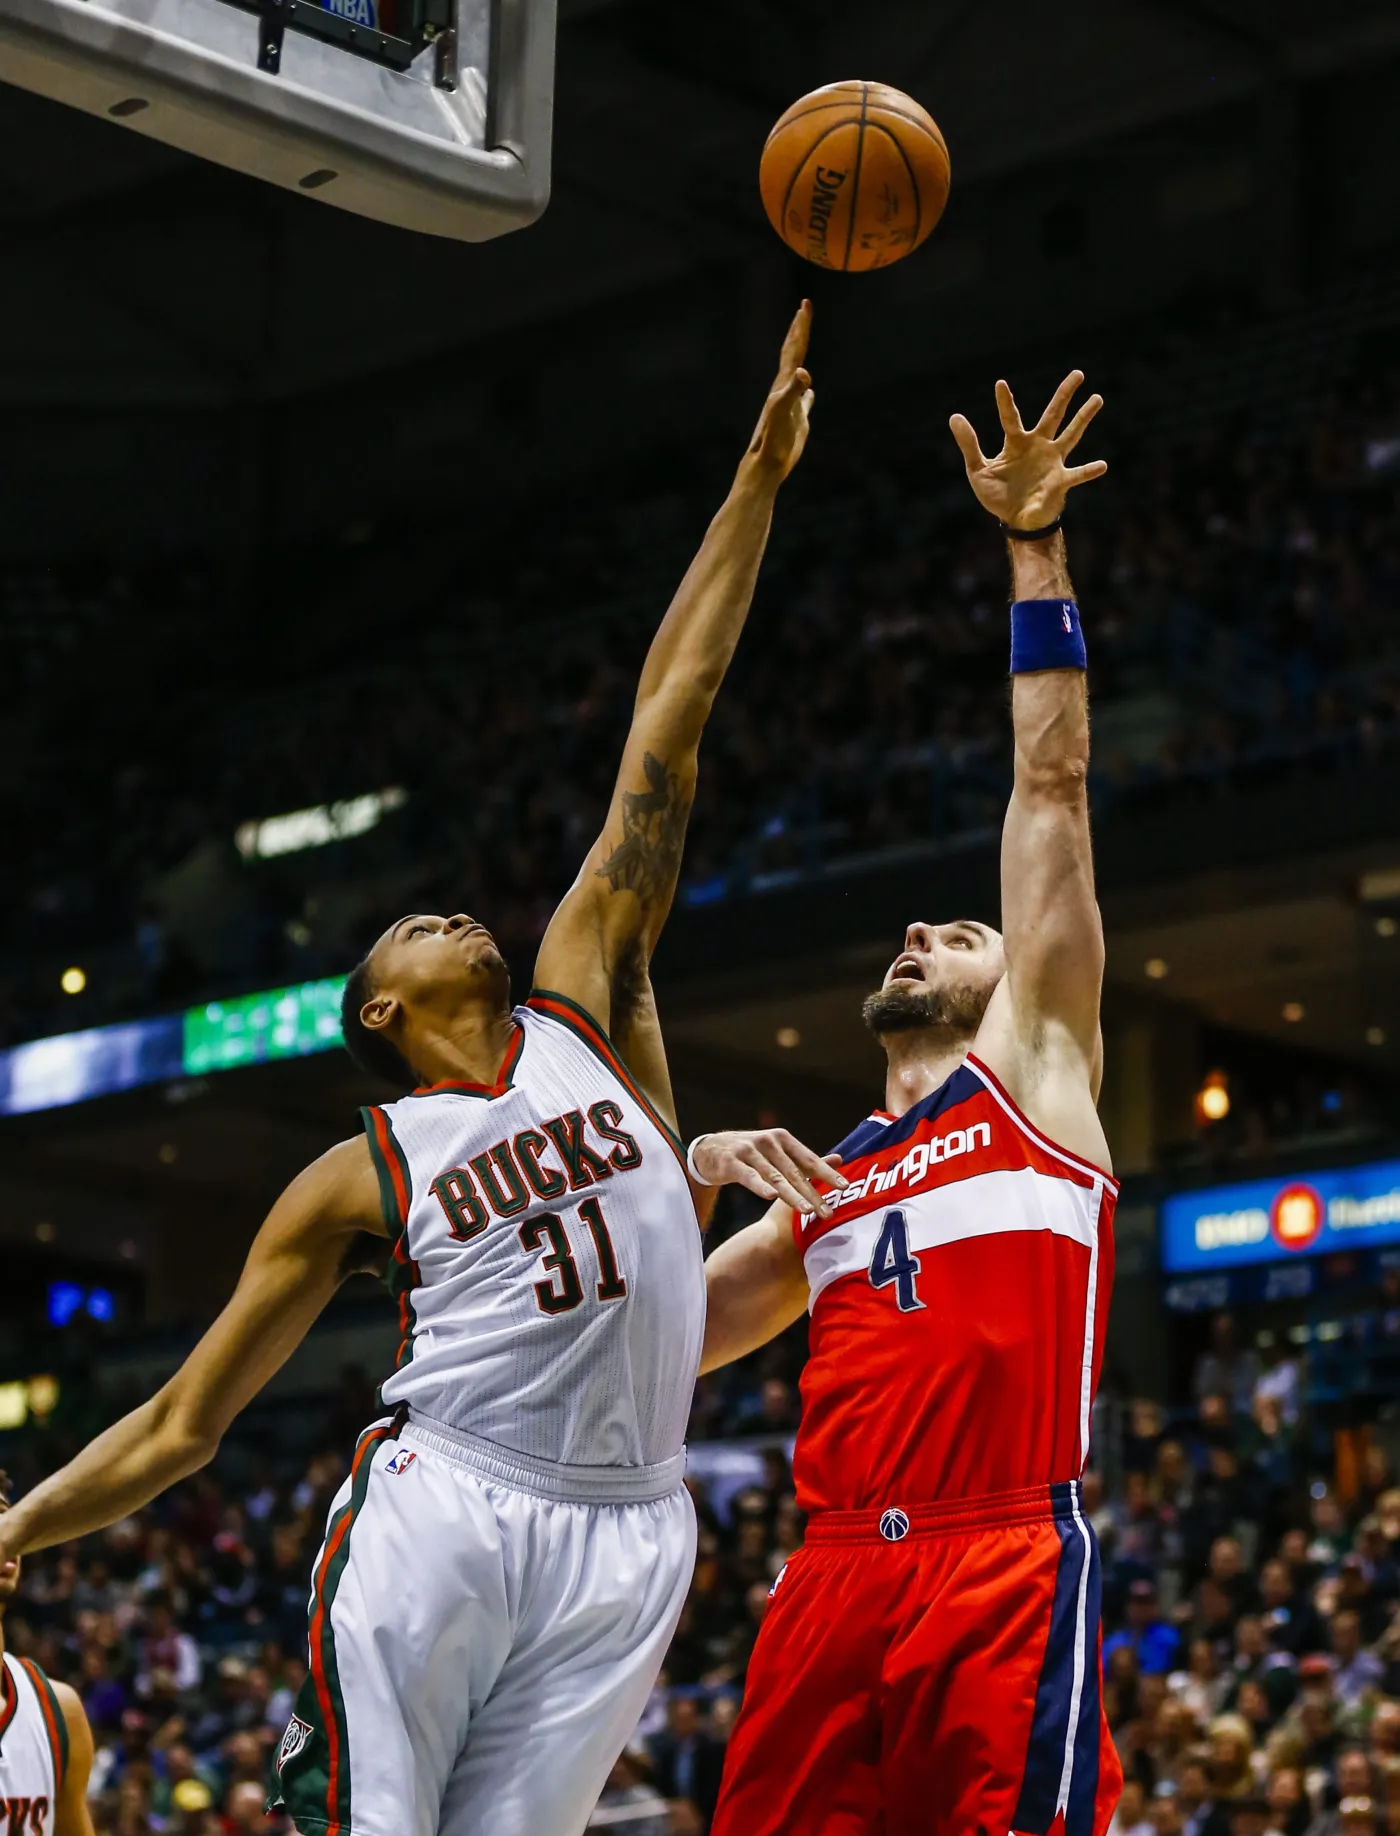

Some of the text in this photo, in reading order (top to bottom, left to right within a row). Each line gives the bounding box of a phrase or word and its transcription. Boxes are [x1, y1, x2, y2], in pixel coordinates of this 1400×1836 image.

[806, 165, 847, 269] PALDING
[428, 1099, 643, 1242] BUCKS
[517, 1196, 627, 1315] 31
[867, 1207, 927, 1313] 4
